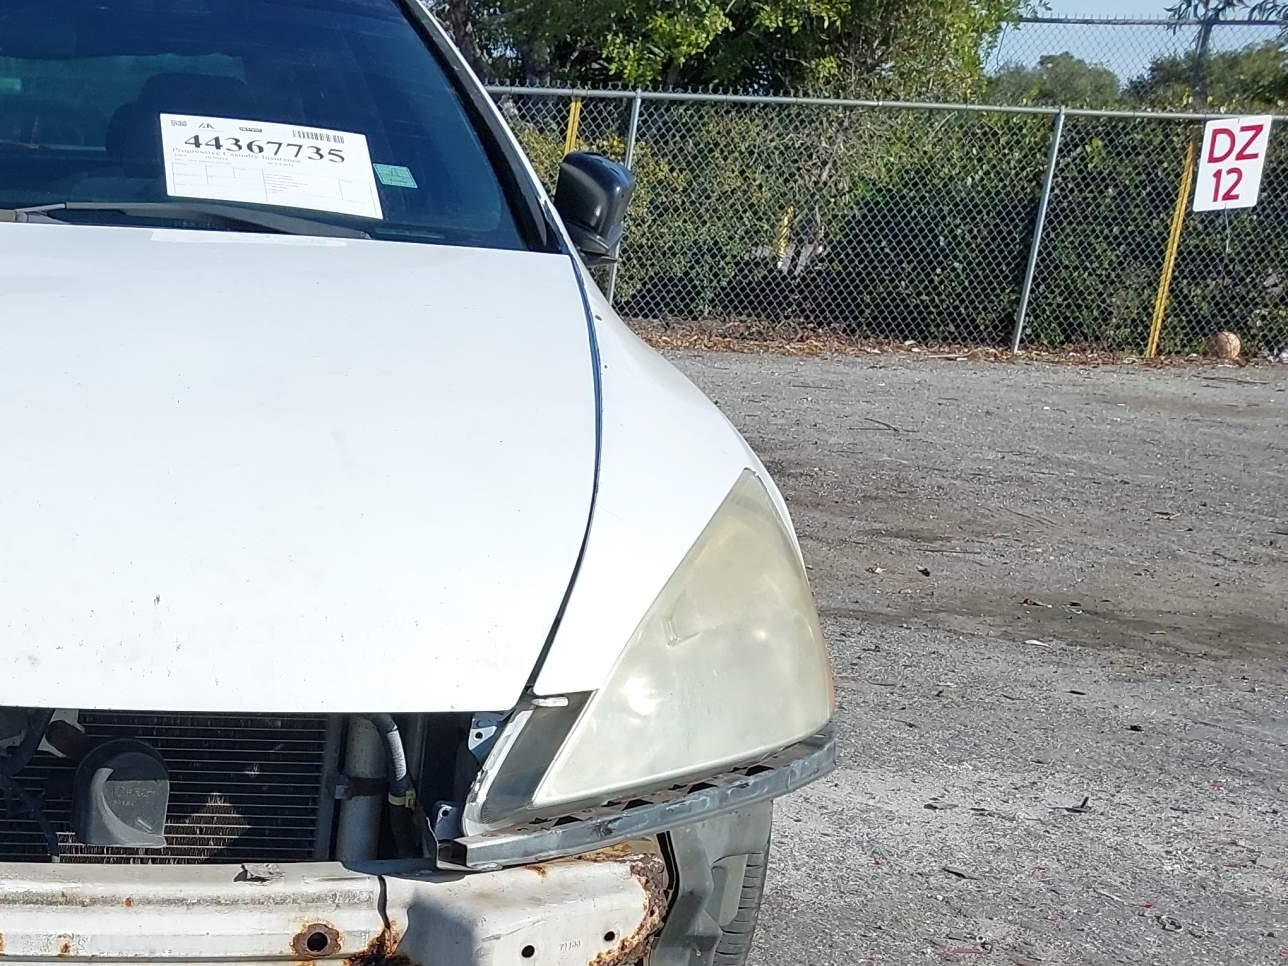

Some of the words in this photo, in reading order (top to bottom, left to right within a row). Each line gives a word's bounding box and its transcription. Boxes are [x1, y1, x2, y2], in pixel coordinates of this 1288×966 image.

[184, 133, 346, 164] 44367735
[1207, 124, 1264, 164] DZ
[1212, 167, 1243, 203] 12
